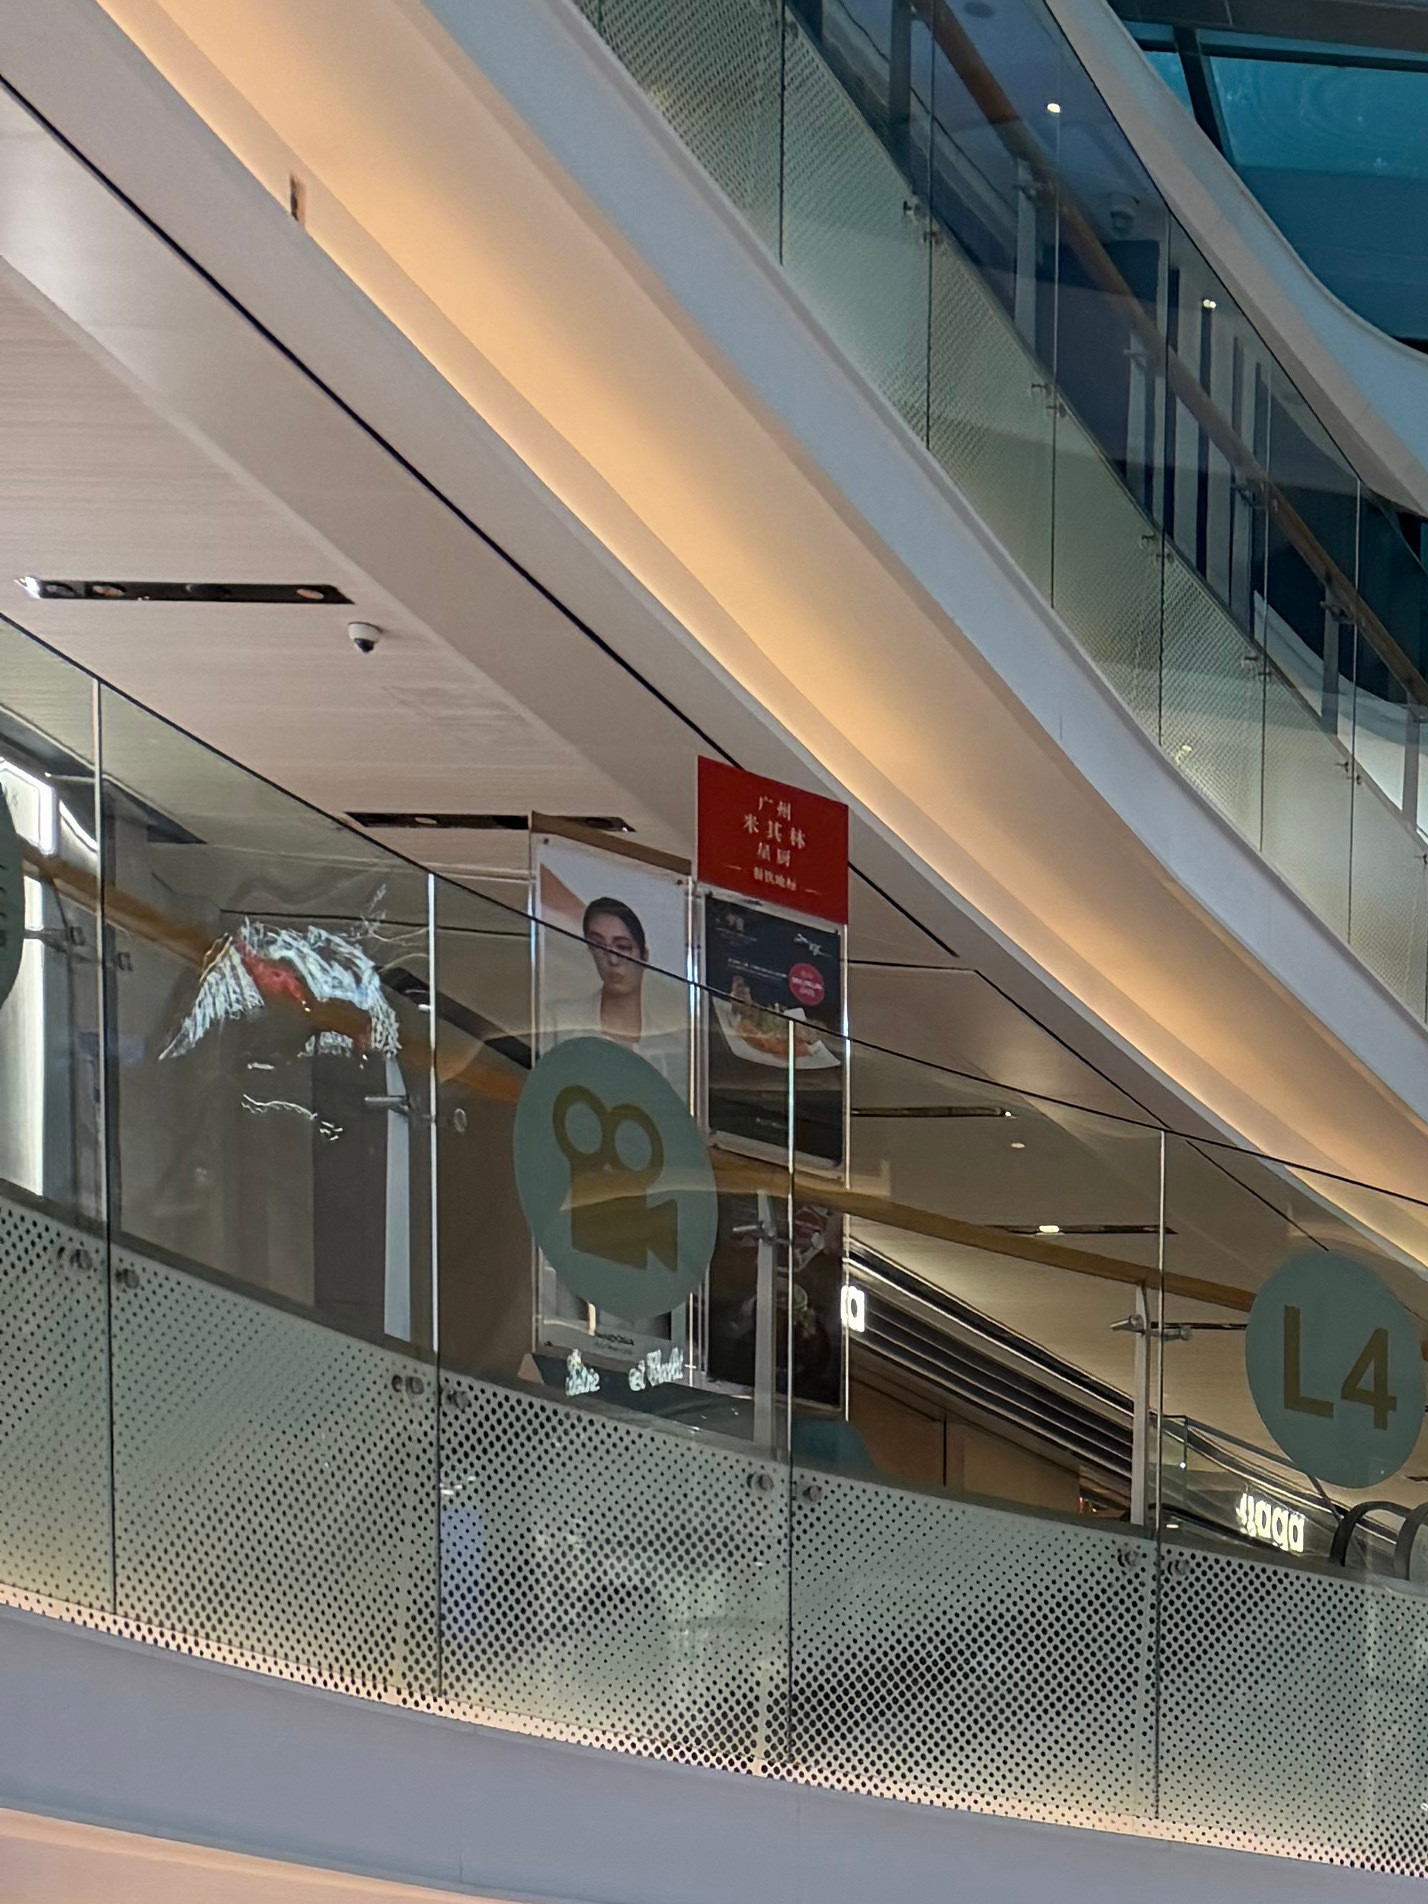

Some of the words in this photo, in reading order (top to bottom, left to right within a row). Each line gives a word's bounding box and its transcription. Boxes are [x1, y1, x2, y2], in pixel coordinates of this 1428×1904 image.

[757, 796, 792, 821] 广州
[743, 812, 807, 849] 米其林
[1282, 1304, 1399, 1431] L4
